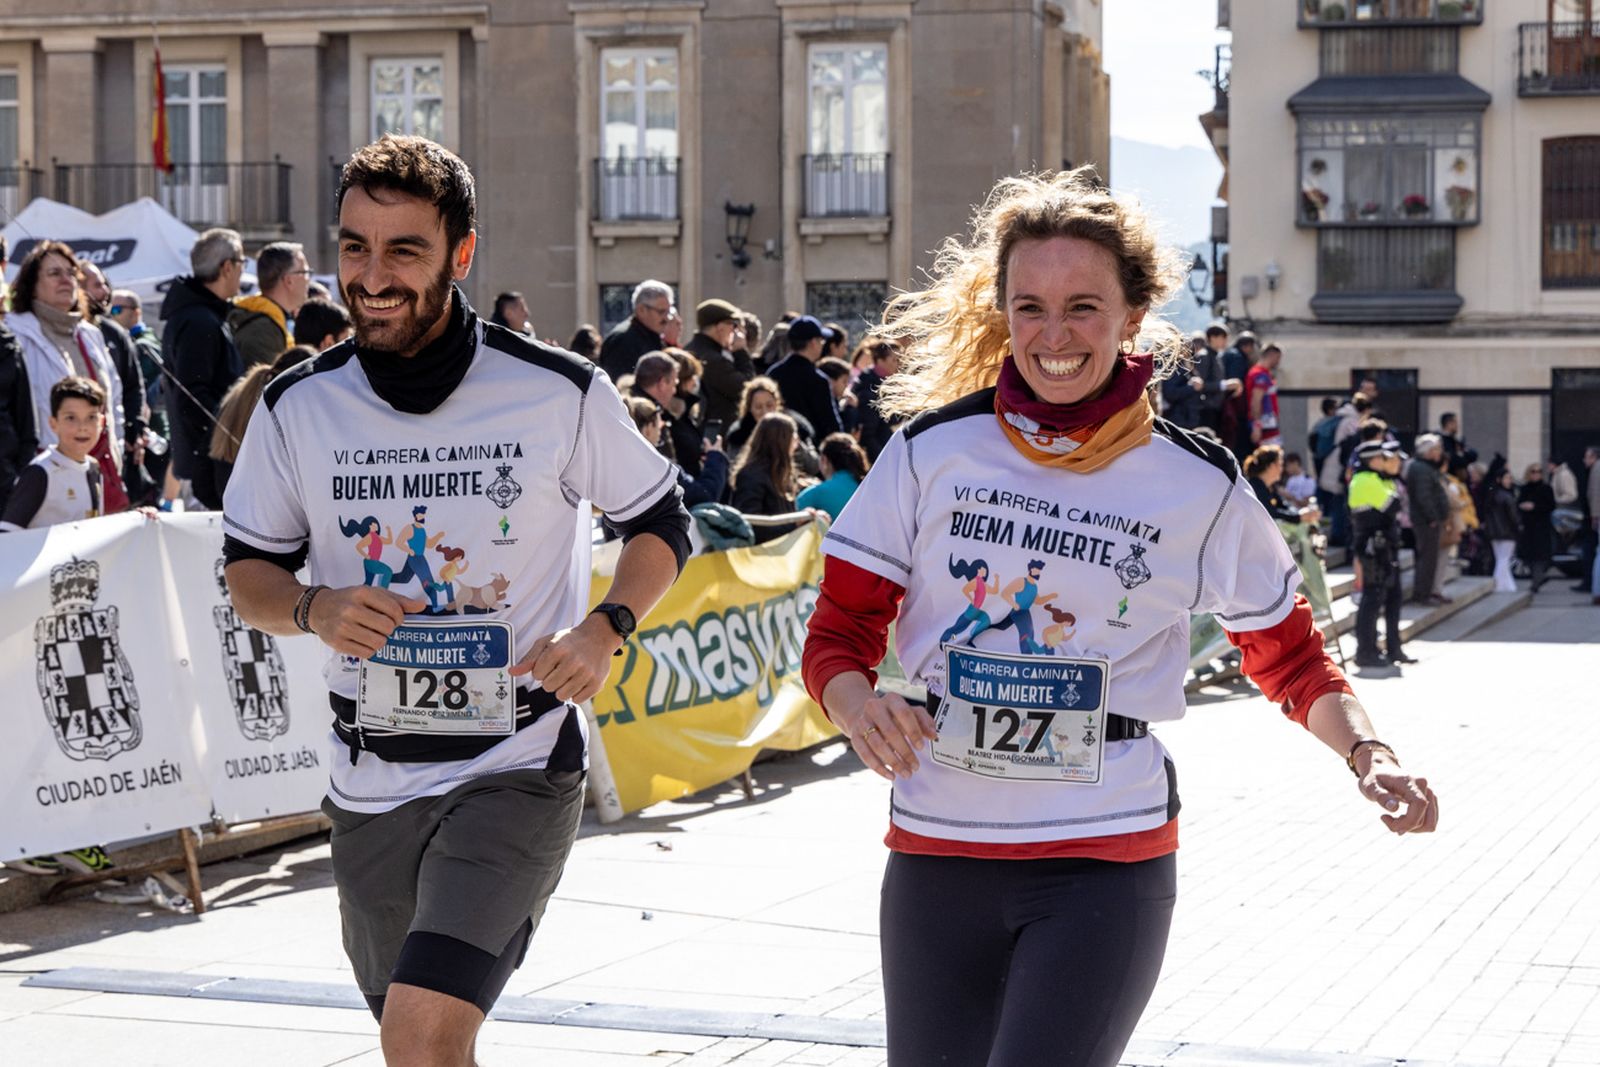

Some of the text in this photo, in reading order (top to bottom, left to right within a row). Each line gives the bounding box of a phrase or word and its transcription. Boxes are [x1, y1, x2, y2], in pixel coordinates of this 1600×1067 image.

[333, 442, 524, 465] VI CARRERA CAMINATA
[332, 475, 396, 501] BUENA
[402, 471, 483, 499] MUERTE
[953, 485, 1162, 544] VI CARRERA CAMINATA
[949, 511, 1116, 567] BUENA MUERTE
[388, 630, 492, 643] ARRERA CAMINATA
[415, 647, 467, 665] MUERTE
[959, 659, 1083, 681] VI CARRERA CAMINATA
[394, 669, 469, 710] 128
[959, 675, 1055, 704] BUENA MUERTE
[393, 707, 427, 717] FERNANDO
[972, 705, 1056, 754] 127
[225, 745, 320, 779] CIUDAD DE JAÉN
[967, 749, 992, 760] BEATRIZ
[36, 759, 182, 806] CIUDAD DE JAÉN
